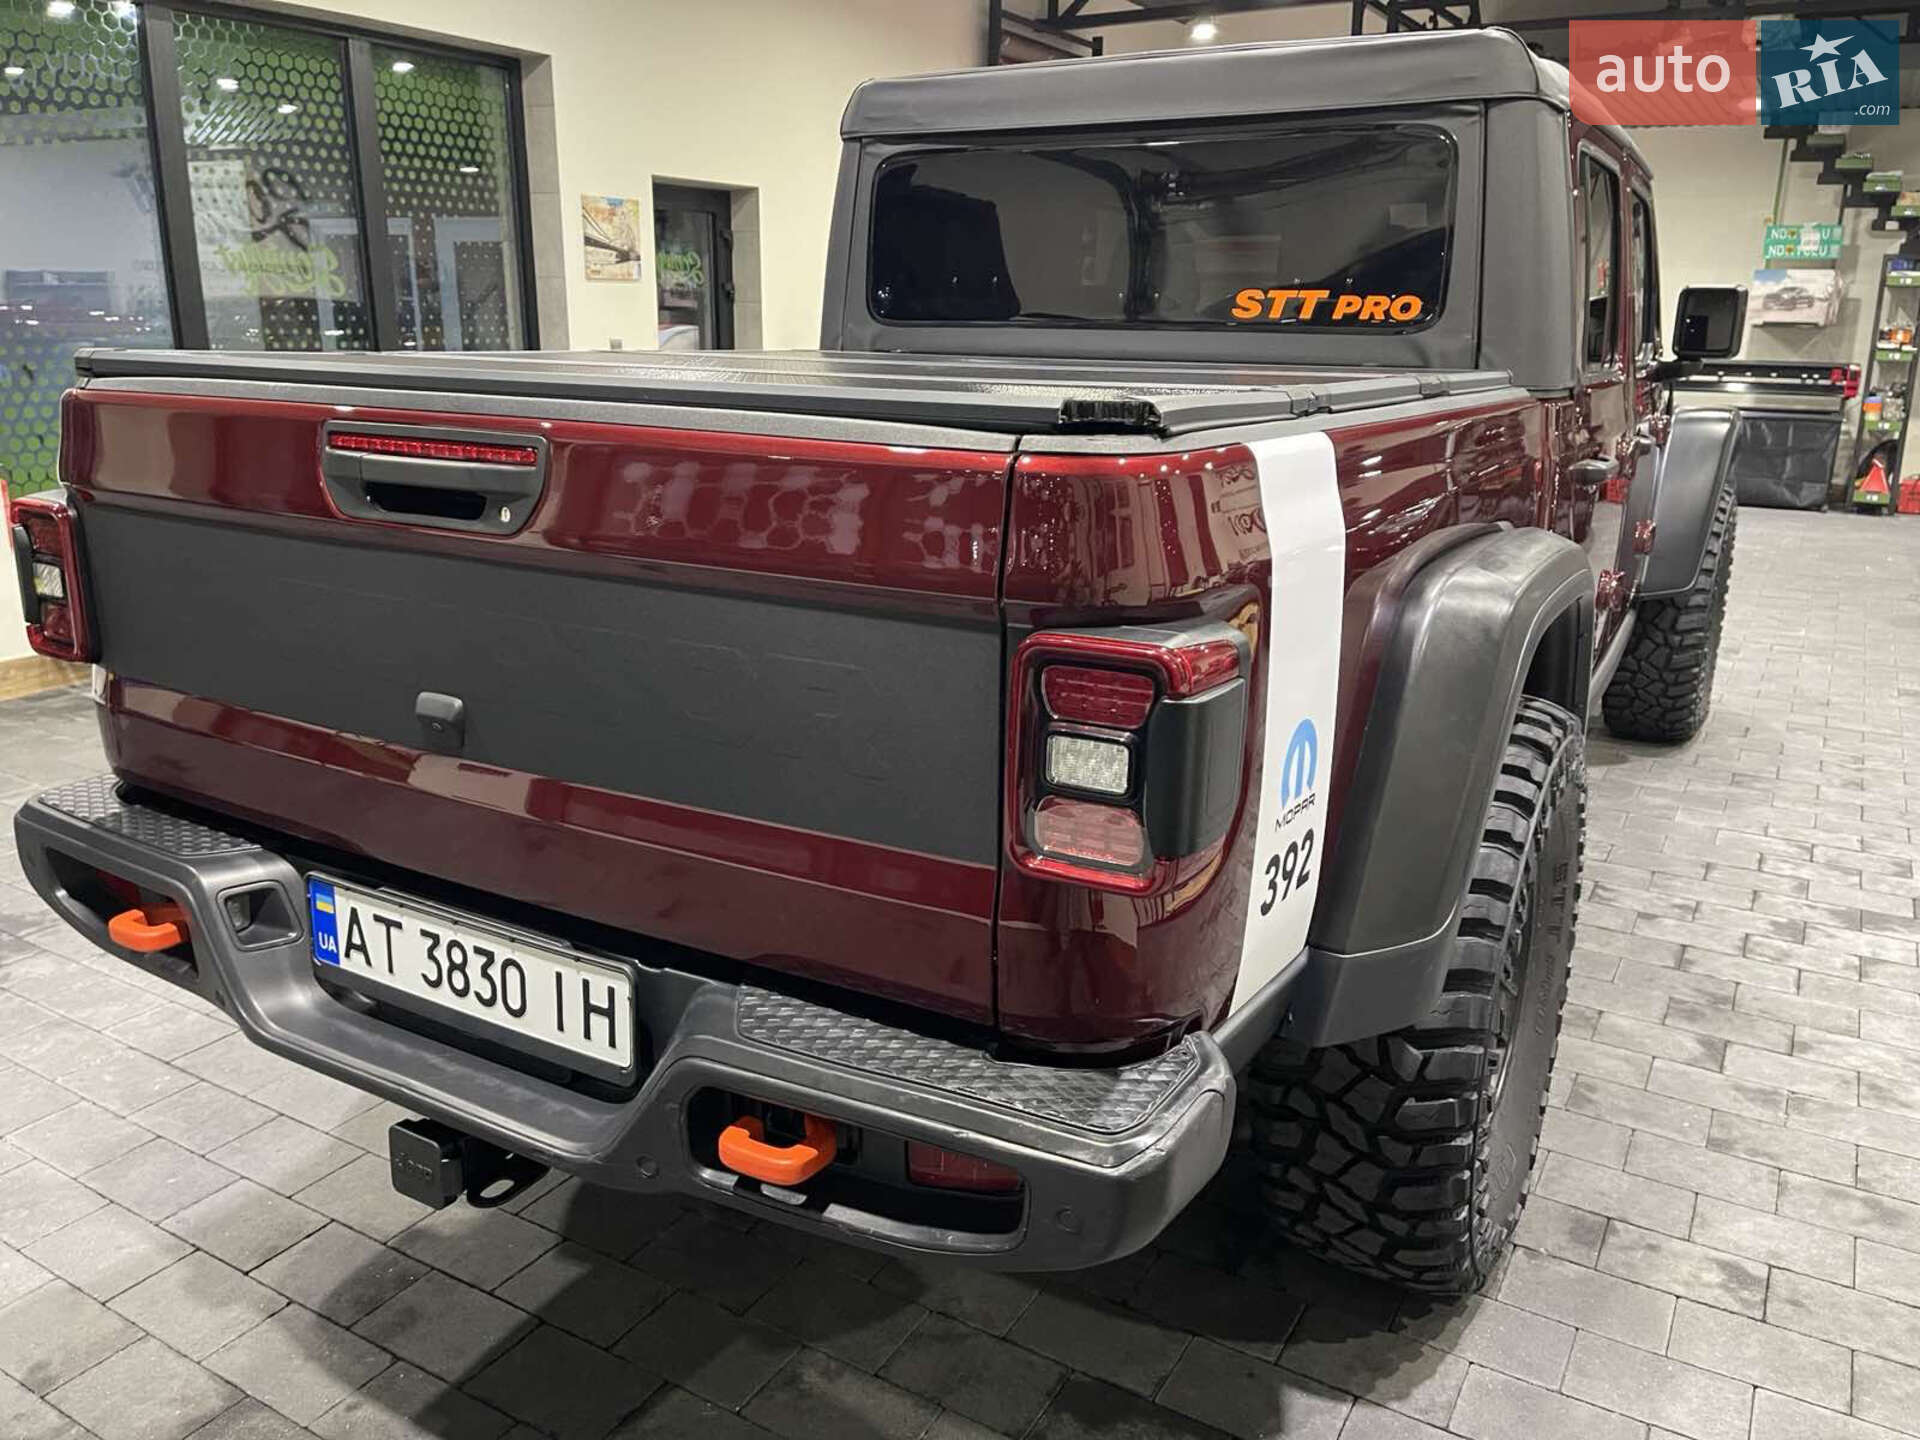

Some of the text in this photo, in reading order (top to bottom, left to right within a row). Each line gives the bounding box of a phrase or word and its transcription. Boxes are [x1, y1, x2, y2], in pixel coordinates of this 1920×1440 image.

[1231, 288, 1422, 321] STT PRO
[1274, 792, 1316, 832] MOPAR
[1260, 827, 1315, 917] 392
[319, 931, 337, 954] UA
[344, 906, 617, 1049] AT 3830 IH
